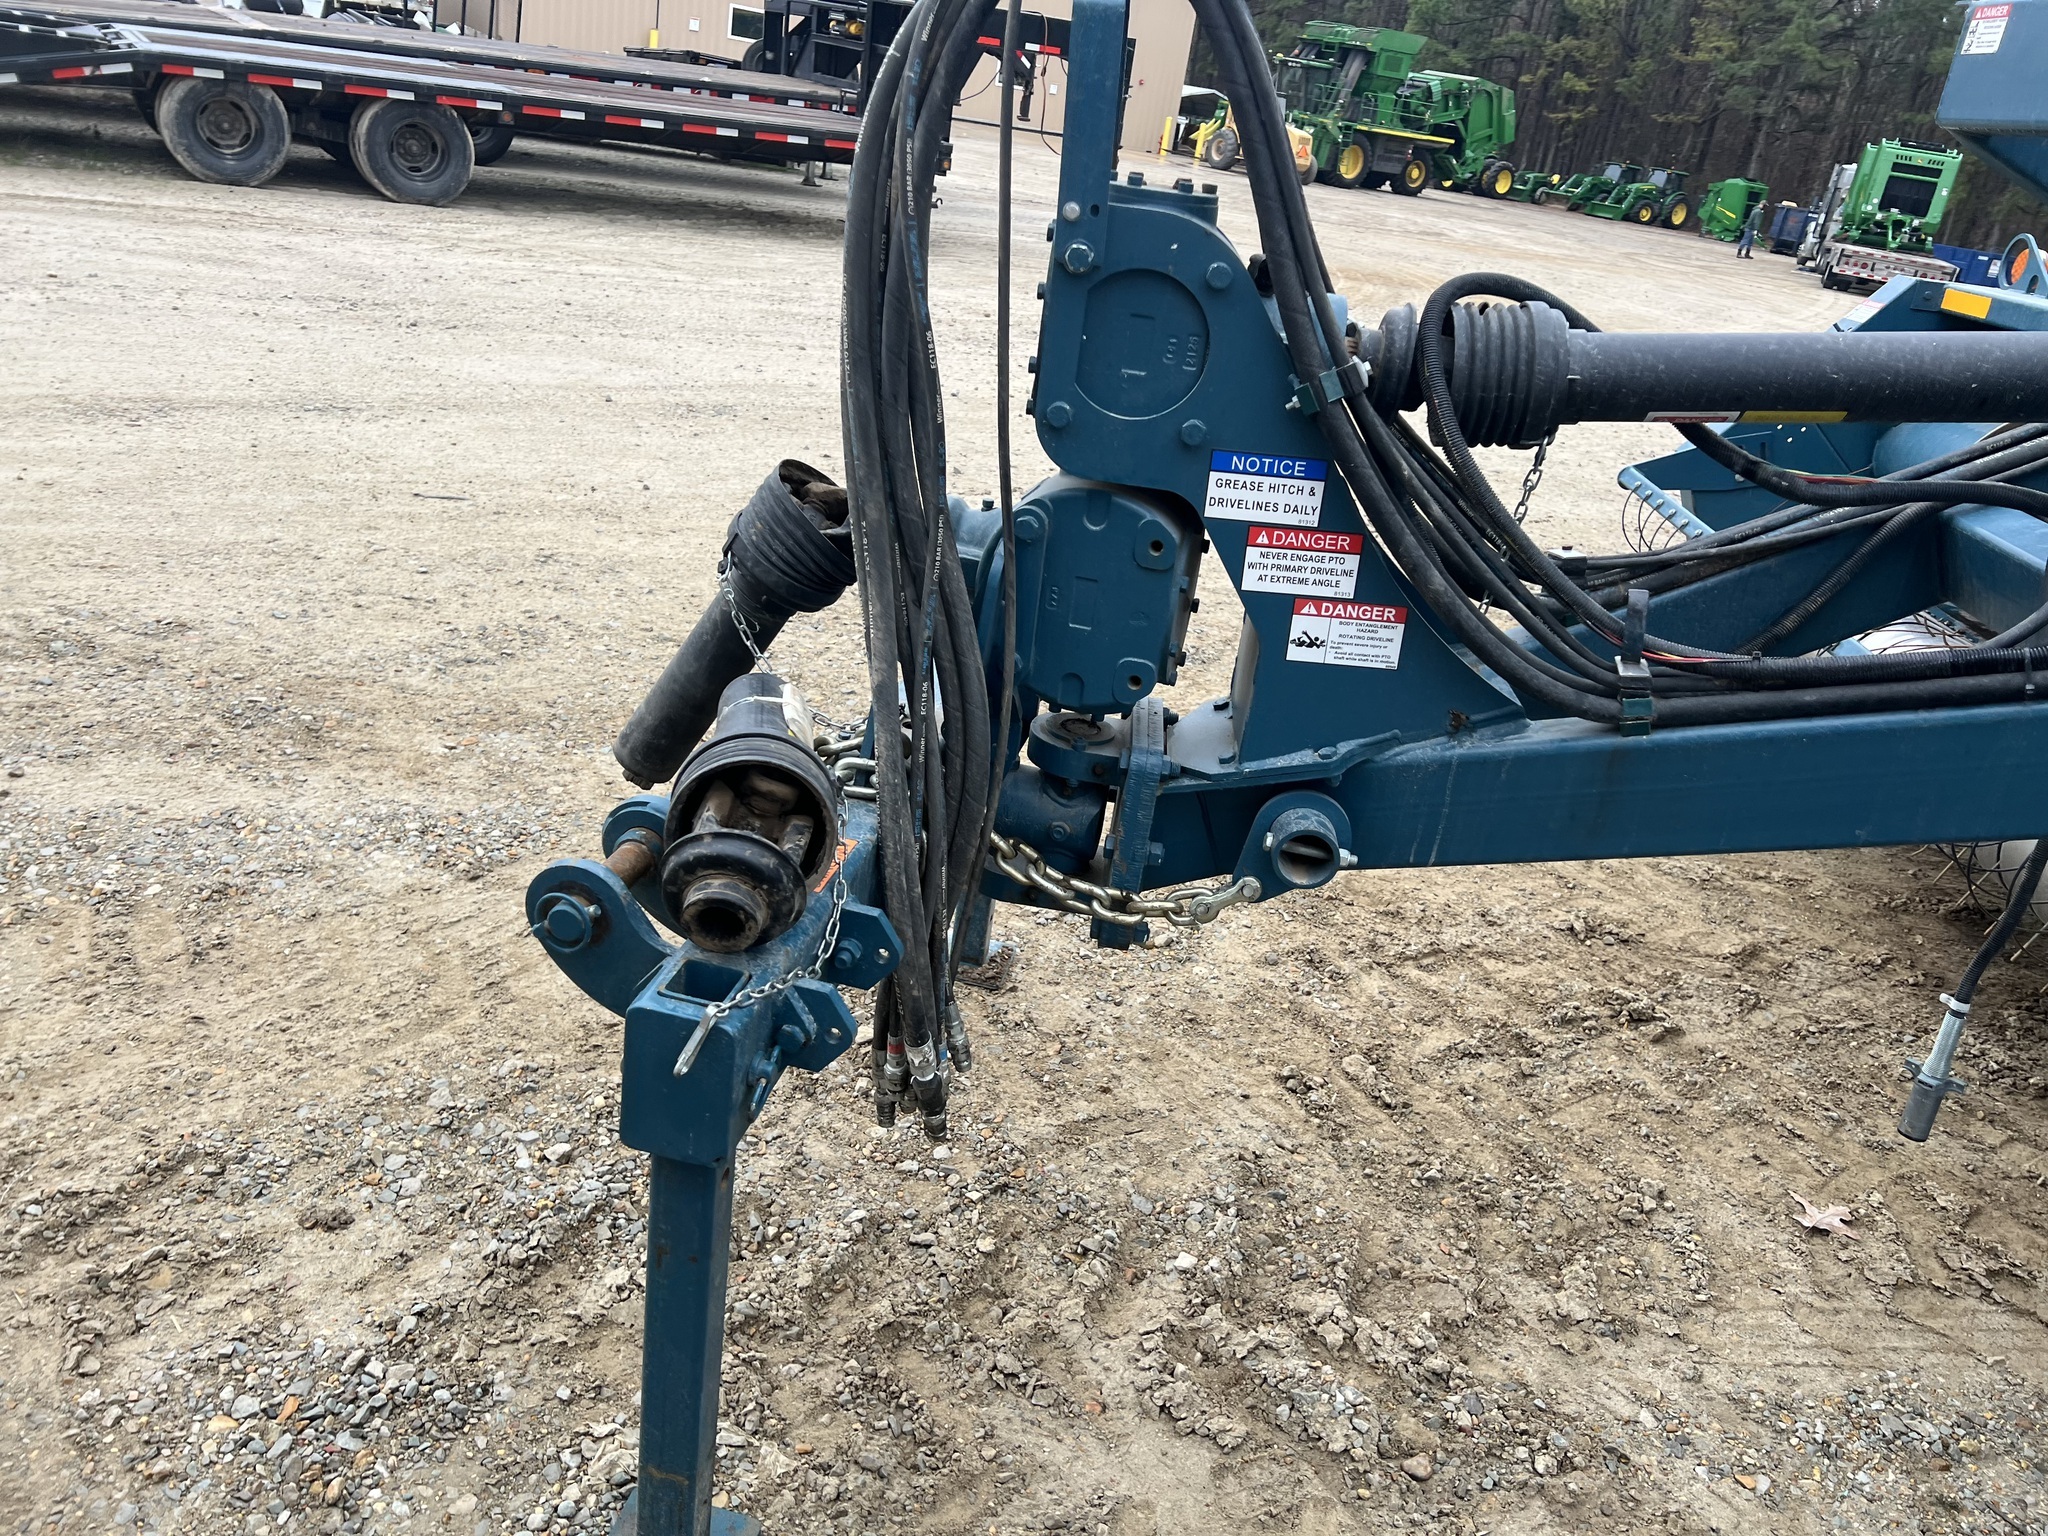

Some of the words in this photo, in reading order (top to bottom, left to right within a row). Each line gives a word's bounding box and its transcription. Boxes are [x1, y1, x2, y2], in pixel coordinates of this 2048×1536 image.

[1982, 5, 2009, 18] DANGER
[920, 12, 935, 42] Winner
[925, 330, 937, 369] EC118-06
[935, 394, 943, 424] Winner
[1231, 455, 1307, 476] NOTICE
[1215, 478, 1264, 492] GREASE
[1268, 483, 1304, 496] HITCH
[1308, 486, 1316, 497] &
[1208, 496, 1279, 513] DRIVELINES
[1283, 503, 1319, 516] DAILY
[1458, 498, 1475, 518] Winner
[1272, 530, 1350, 551] DANGER
[1259, 551, 1289, 561] NEVER
[1290, 553, 1326, 564] ENGAGE
[1328, 556, 1346, 565] PTO
[1247, 562, 1268, 571] WITH
[1270, 564, 1308, 575] PRIMARY
[1310, 567, 1354, 578] DRIVELINE
[1257, 574, 1268, 582] AT
[1270, 576, 1310, 586] EXTREME
[1311, 579, 1341, 589] ANGLE
[1320, 602, 1396, 622] DANGER
[1355, 622, 1399, 630] ENTANGLEMENT
[920, 681, 929, 715] EC118-06
[918, 737, 926, 763] Winner
